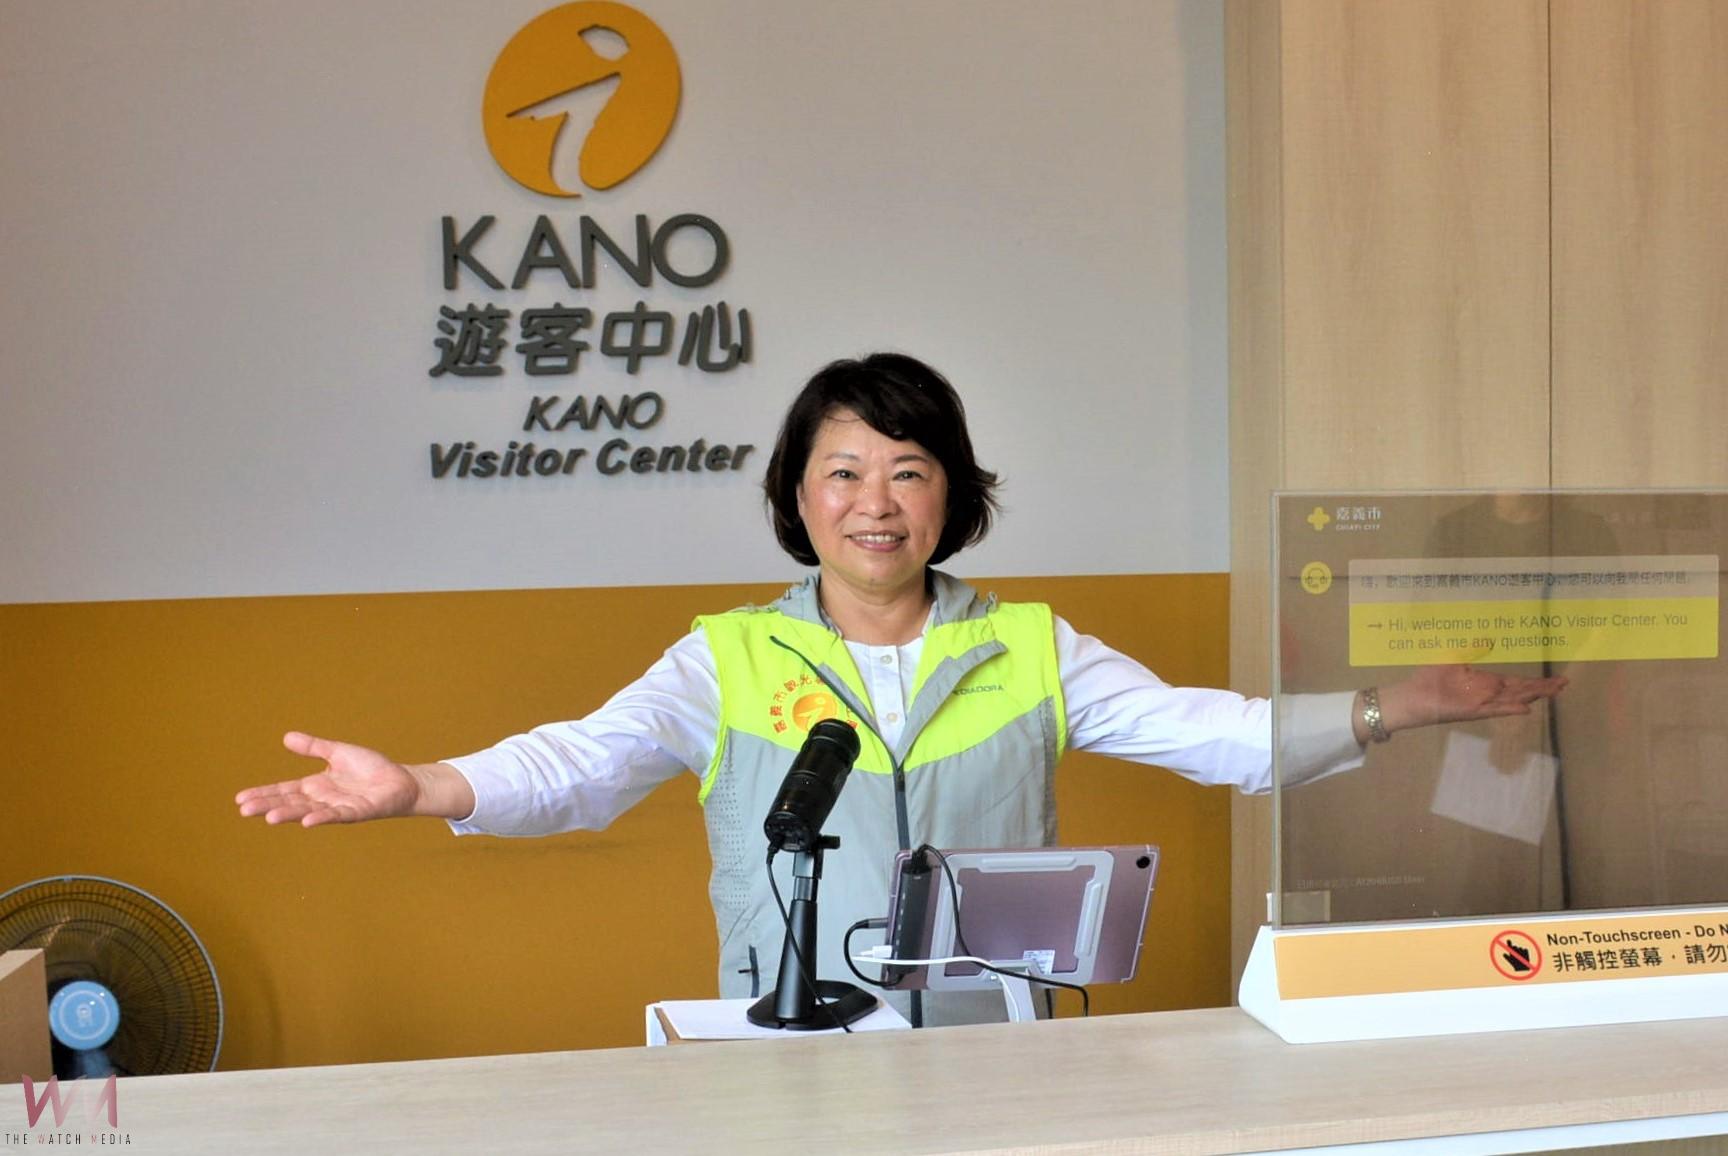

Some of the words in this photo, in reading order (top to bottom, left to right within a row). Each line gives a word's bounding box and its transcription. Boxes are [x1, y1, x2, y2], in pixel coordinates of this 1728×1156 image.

[442, 213, 731, 290] KANO
[429, 301, 754, 377] 遊客中心
[523, 391, 666, 432] KANO
[430, 440, 587, 479] Visitor
[597, 438, 755, 476] Center
[1336, 505, 1382, 522] 嘉義市
[1389, 617, 1407, 633] Hi,
[1412, 615, 1473, 631] welcome
[1477, 616, 1490, 630] to
[1494, 614, 1515, 630] the
[1520, 614, 1562, 629] KANO
[1567, 613, 1607, 628] Visitor
[1663, 612, 1688, 627] You
[1388, 638, 1414, 650] can
[1418, 635, 1441, 650] ask
[1447, 638, 1468, 649] me
[1471, 637, 1496, 652] any
[1500, 634, 1569, 651] questions.
[1547, 927, 1681, 946] Non-Touchscreen
[1694, 924, 1716, 938] Do
